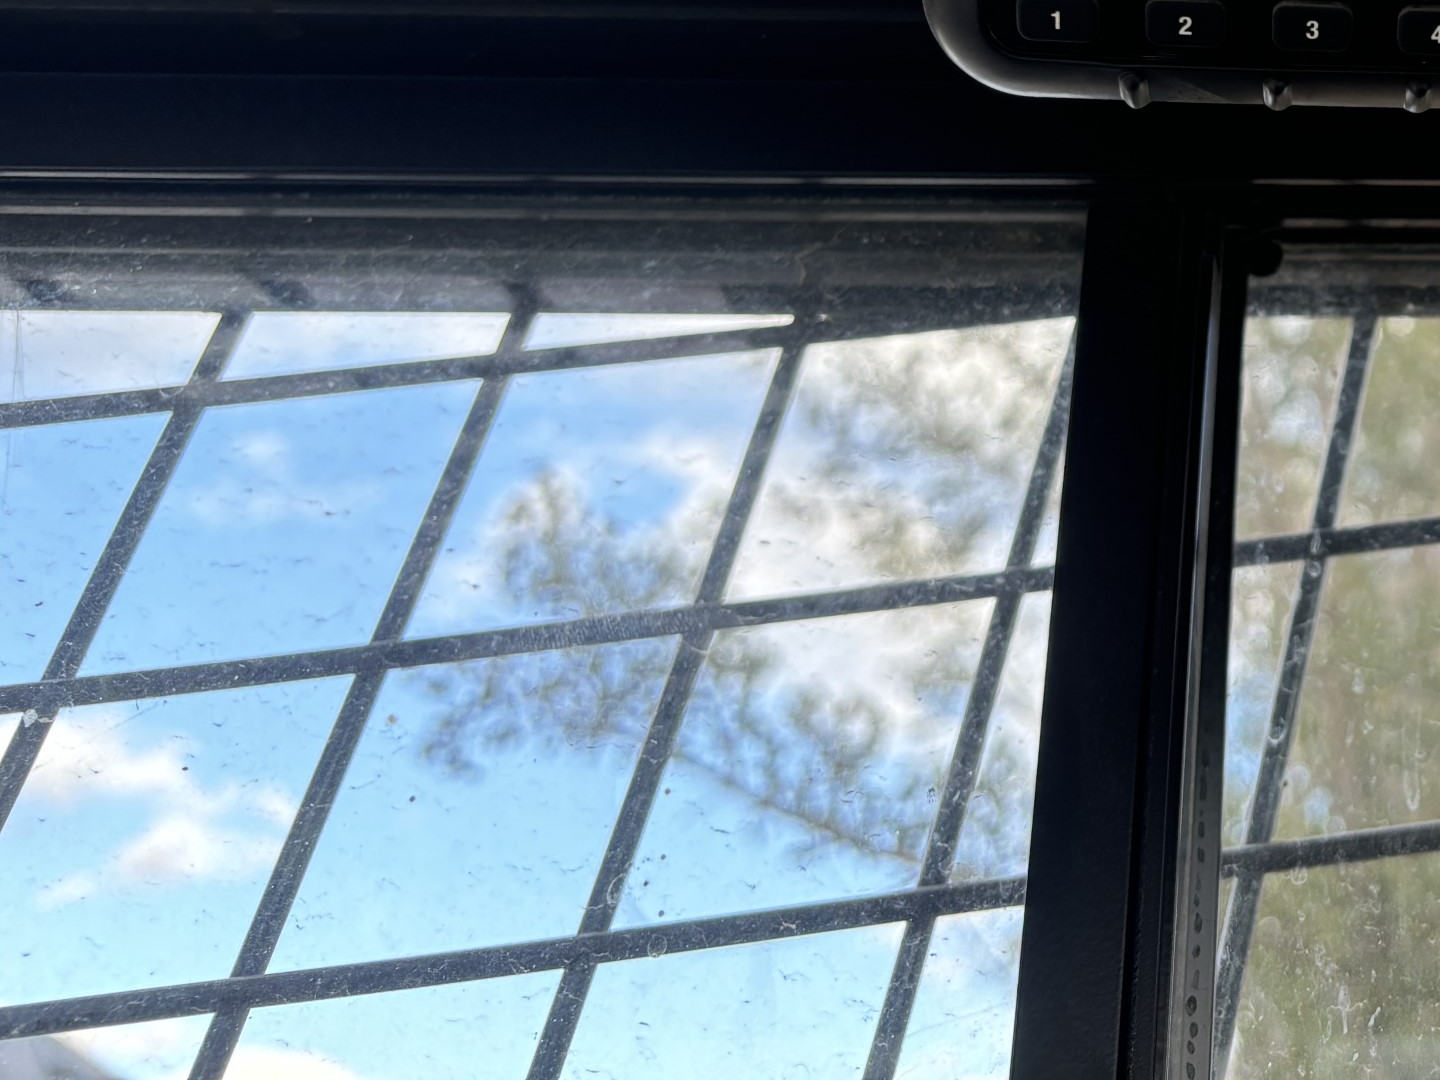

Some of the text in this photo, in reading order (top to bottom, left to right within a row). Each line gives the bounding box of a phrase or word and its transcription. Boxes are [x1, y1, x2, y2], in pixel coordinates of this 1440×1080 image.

[1050, 10, 1061, 30] 1
[1178, 16, 1193, 36] 2
[1305, 20, 1320, 40] 3
